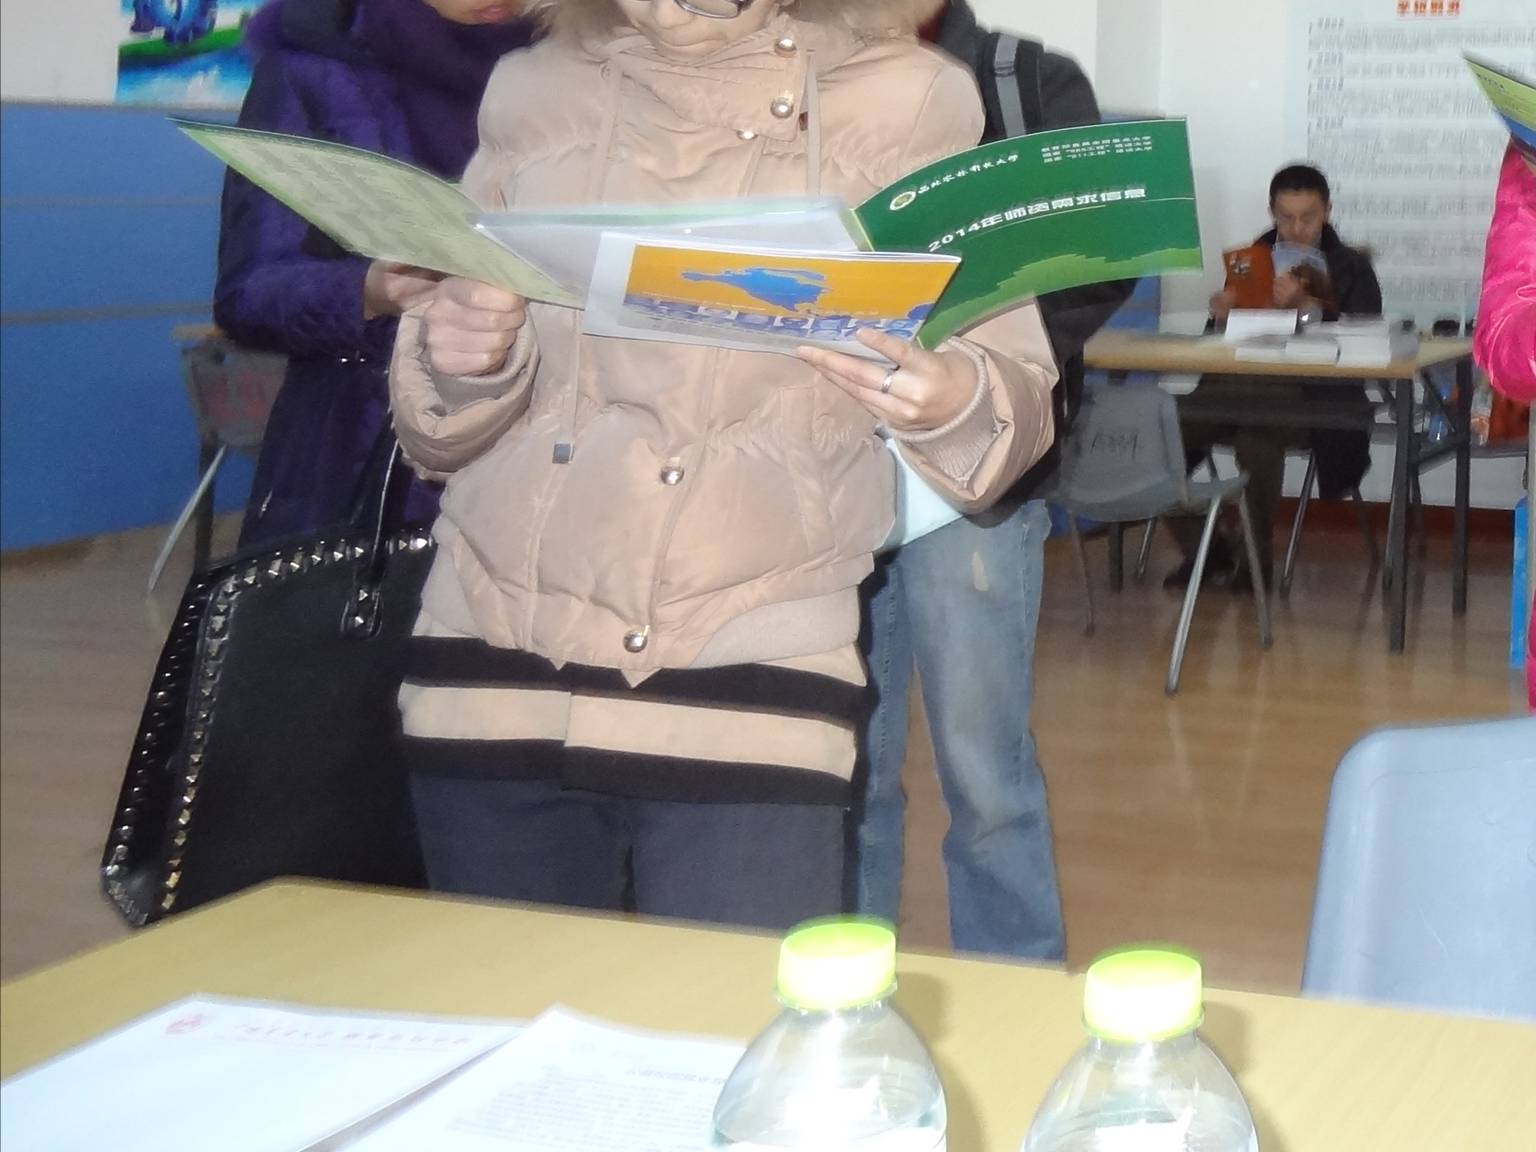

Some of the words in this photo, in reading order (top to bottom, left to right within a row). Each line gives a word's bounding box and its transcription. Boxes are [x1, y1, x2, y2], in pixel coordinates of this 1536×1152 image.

[928, 187, 1146, 252] 2014年师资需求信息
